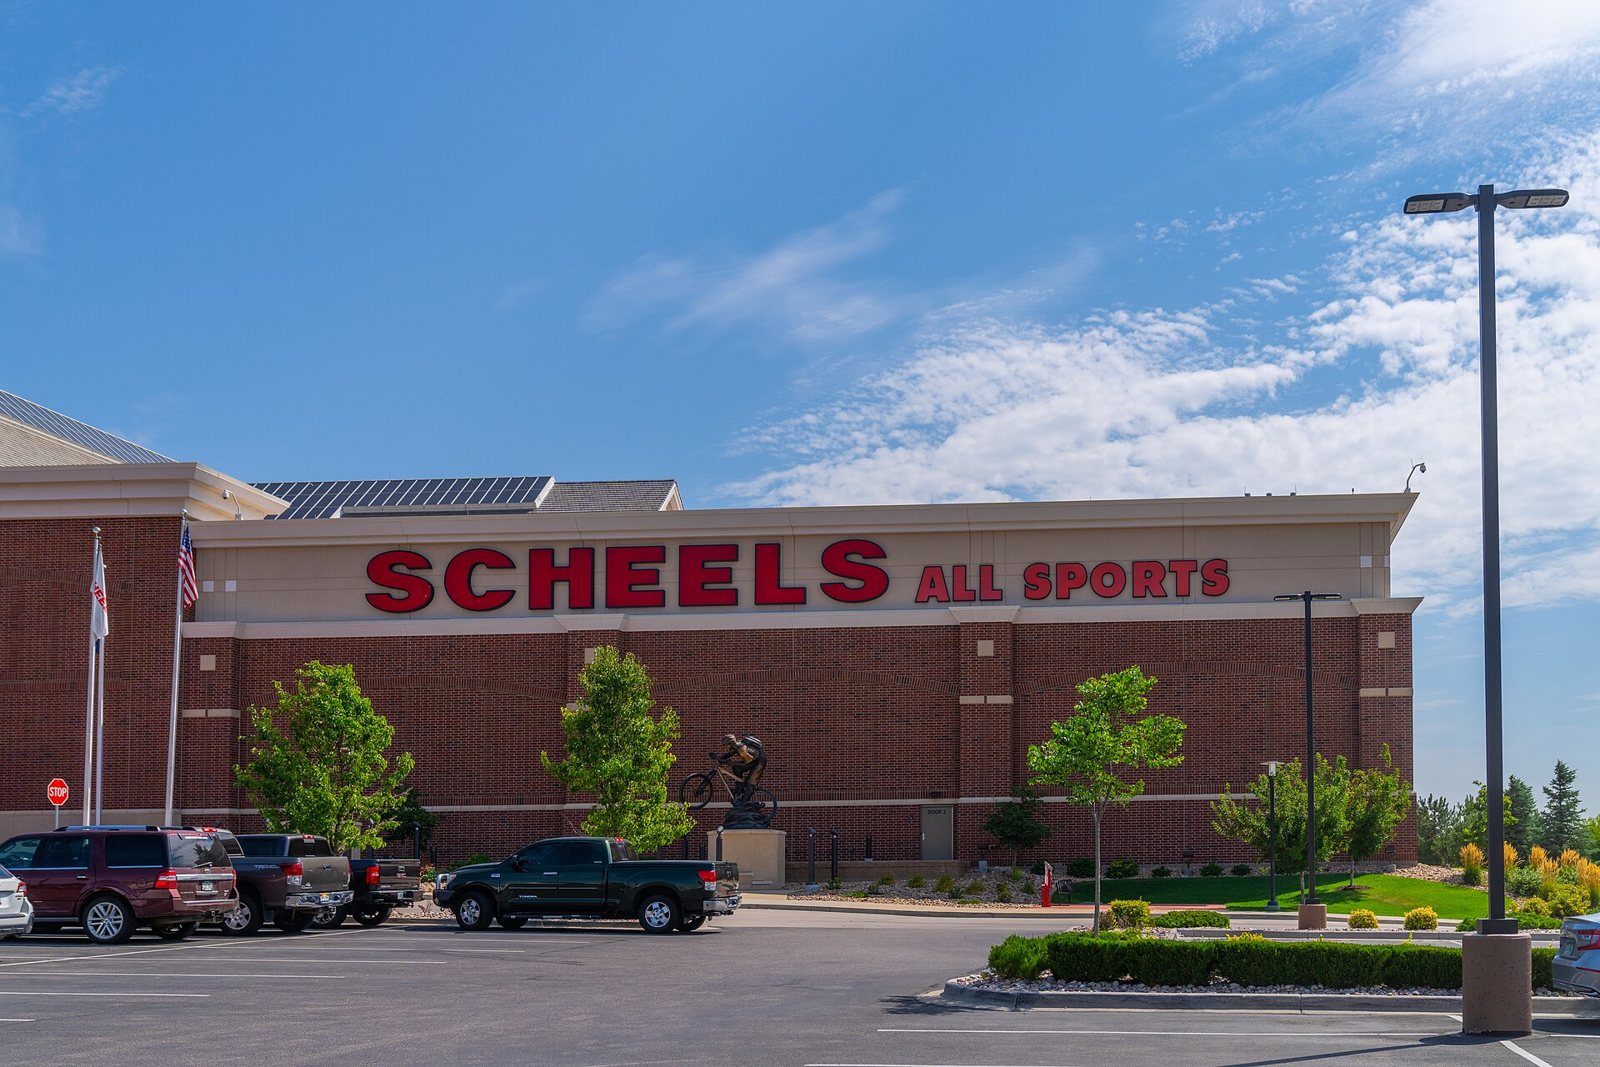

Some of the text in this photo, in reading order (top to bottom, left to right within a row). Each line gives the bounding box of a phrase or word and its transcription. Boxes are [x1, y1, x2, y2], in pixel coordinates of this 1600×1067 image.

[365, 539, 1230, 613] SCHEELS ALL SPORTS
[49, 786, 67, 797] STOP
